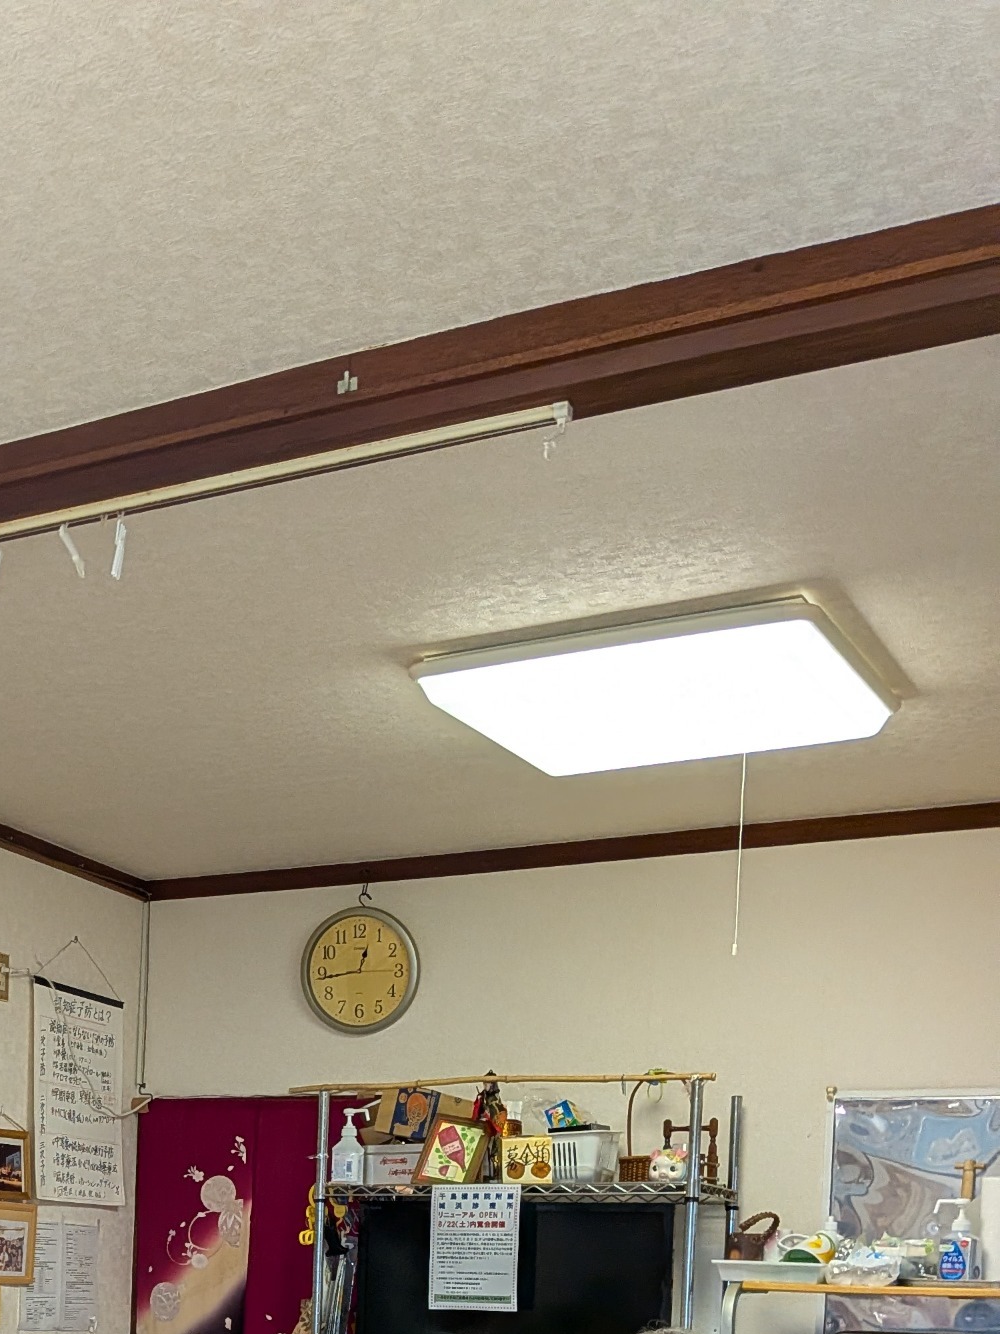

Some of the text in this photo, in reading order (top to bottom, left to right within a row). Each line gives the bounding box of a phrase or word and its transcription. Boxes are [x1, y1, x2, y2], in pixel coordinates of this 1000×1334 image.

[336, 930, 347, 944] 11
[353, 924, 367, 938] 12
[377, 928, 382, 942] 1
[322, 945, 336, 960] 10
[388, 943, 397, 957] 2
[318, 966, 327, 979] 9
[394, 963, 404, 978] 3
[324, 986, 333, 1000] 8
[387, 984, 397, 997] 4
[338, 1000, 347, 1014] 7
[354, 1004, 364, 1018] 6
[374, 1000, 383, 1013] 5
[438, 1211, 476, 1219] リニューアル
